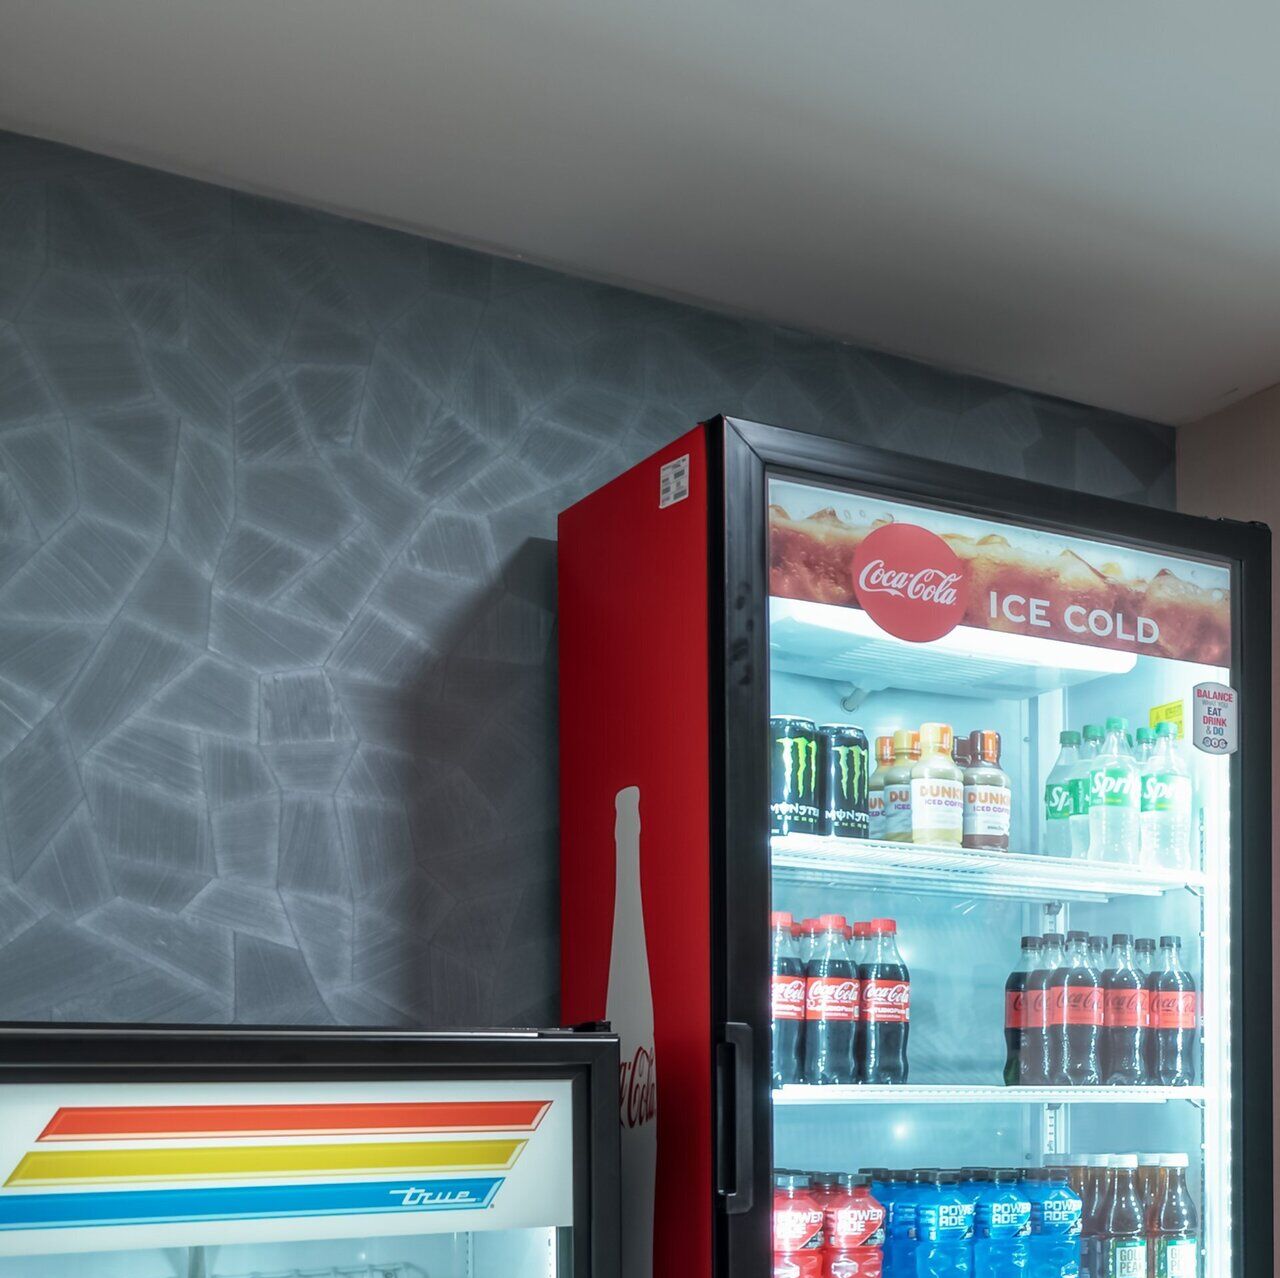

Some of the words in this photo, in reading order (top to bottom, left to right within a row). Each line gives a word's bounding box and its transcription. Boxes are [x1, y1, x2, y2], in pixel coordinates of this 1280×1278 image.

[859, 558, 963, 606] Coca-Cola
[990, 591, 1051, 628] ICE
[1064, 604, 1160, 644] COLD
[1197, 689, 1233, 702] BALANCE
[1208, 707, 1222, 716] EAT
[1203, 716, 1227, 727] DRINK
[1206, 726, 1211, 734] &
[1213, 727, 1224, 736] DO
[389, 1186, 481, 1206] true
[939, 1216, 966, 1227] ADE
[992, 1214, 1018, 1224] ADE
[1044, 1211, 1069, 1221] ADE
[1120, 1249, 1141, 1261] GOL
